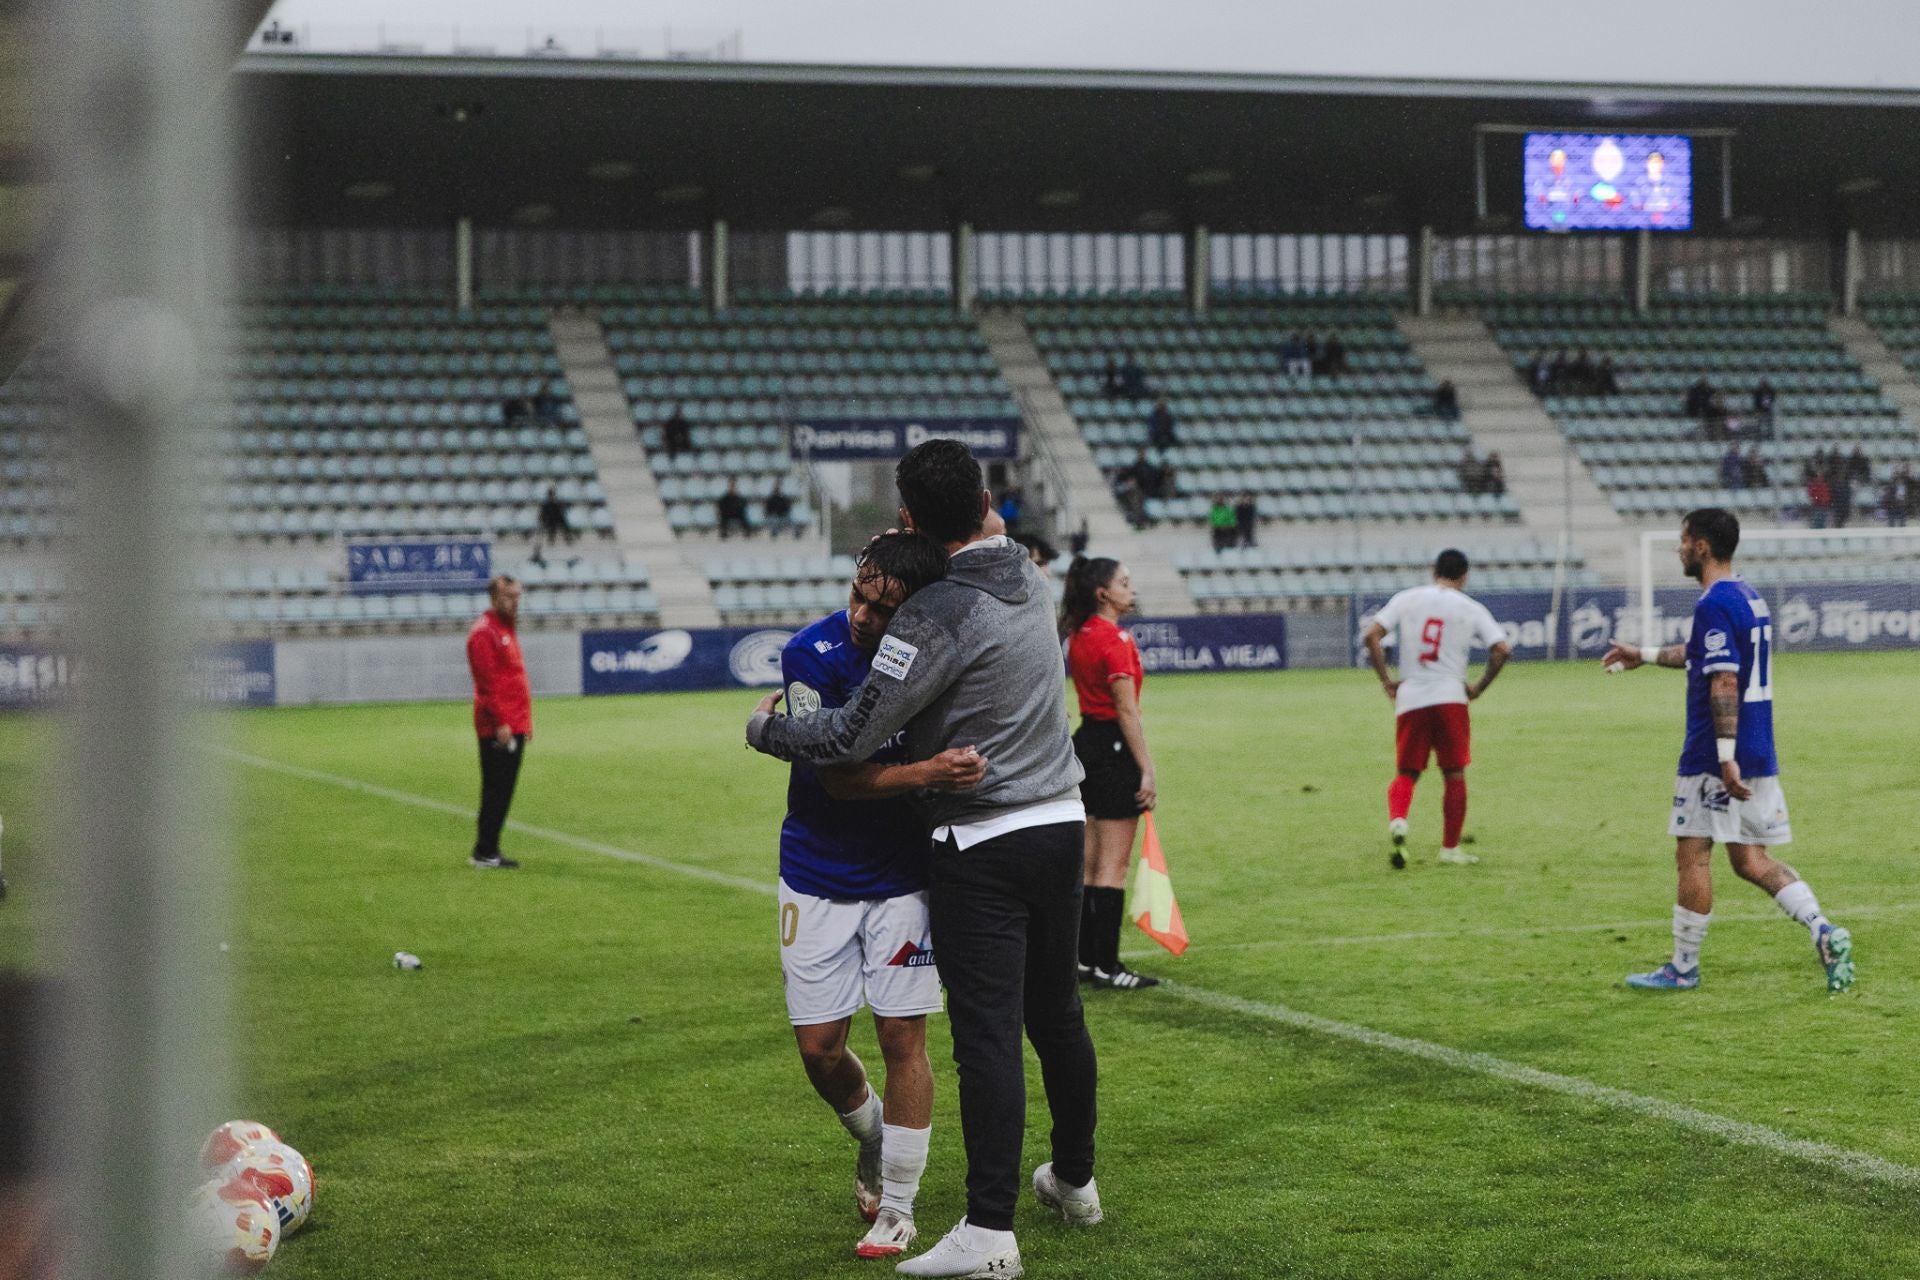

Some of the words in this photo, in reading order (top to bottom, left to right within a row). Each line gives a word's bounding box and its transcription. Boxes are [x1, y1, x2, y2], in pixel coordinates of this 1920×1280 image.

[1129, 622, 1181, 647] OTEL
[1417, 617, 1445, 664] 9
[1743, 624, 1773, 703] 11
